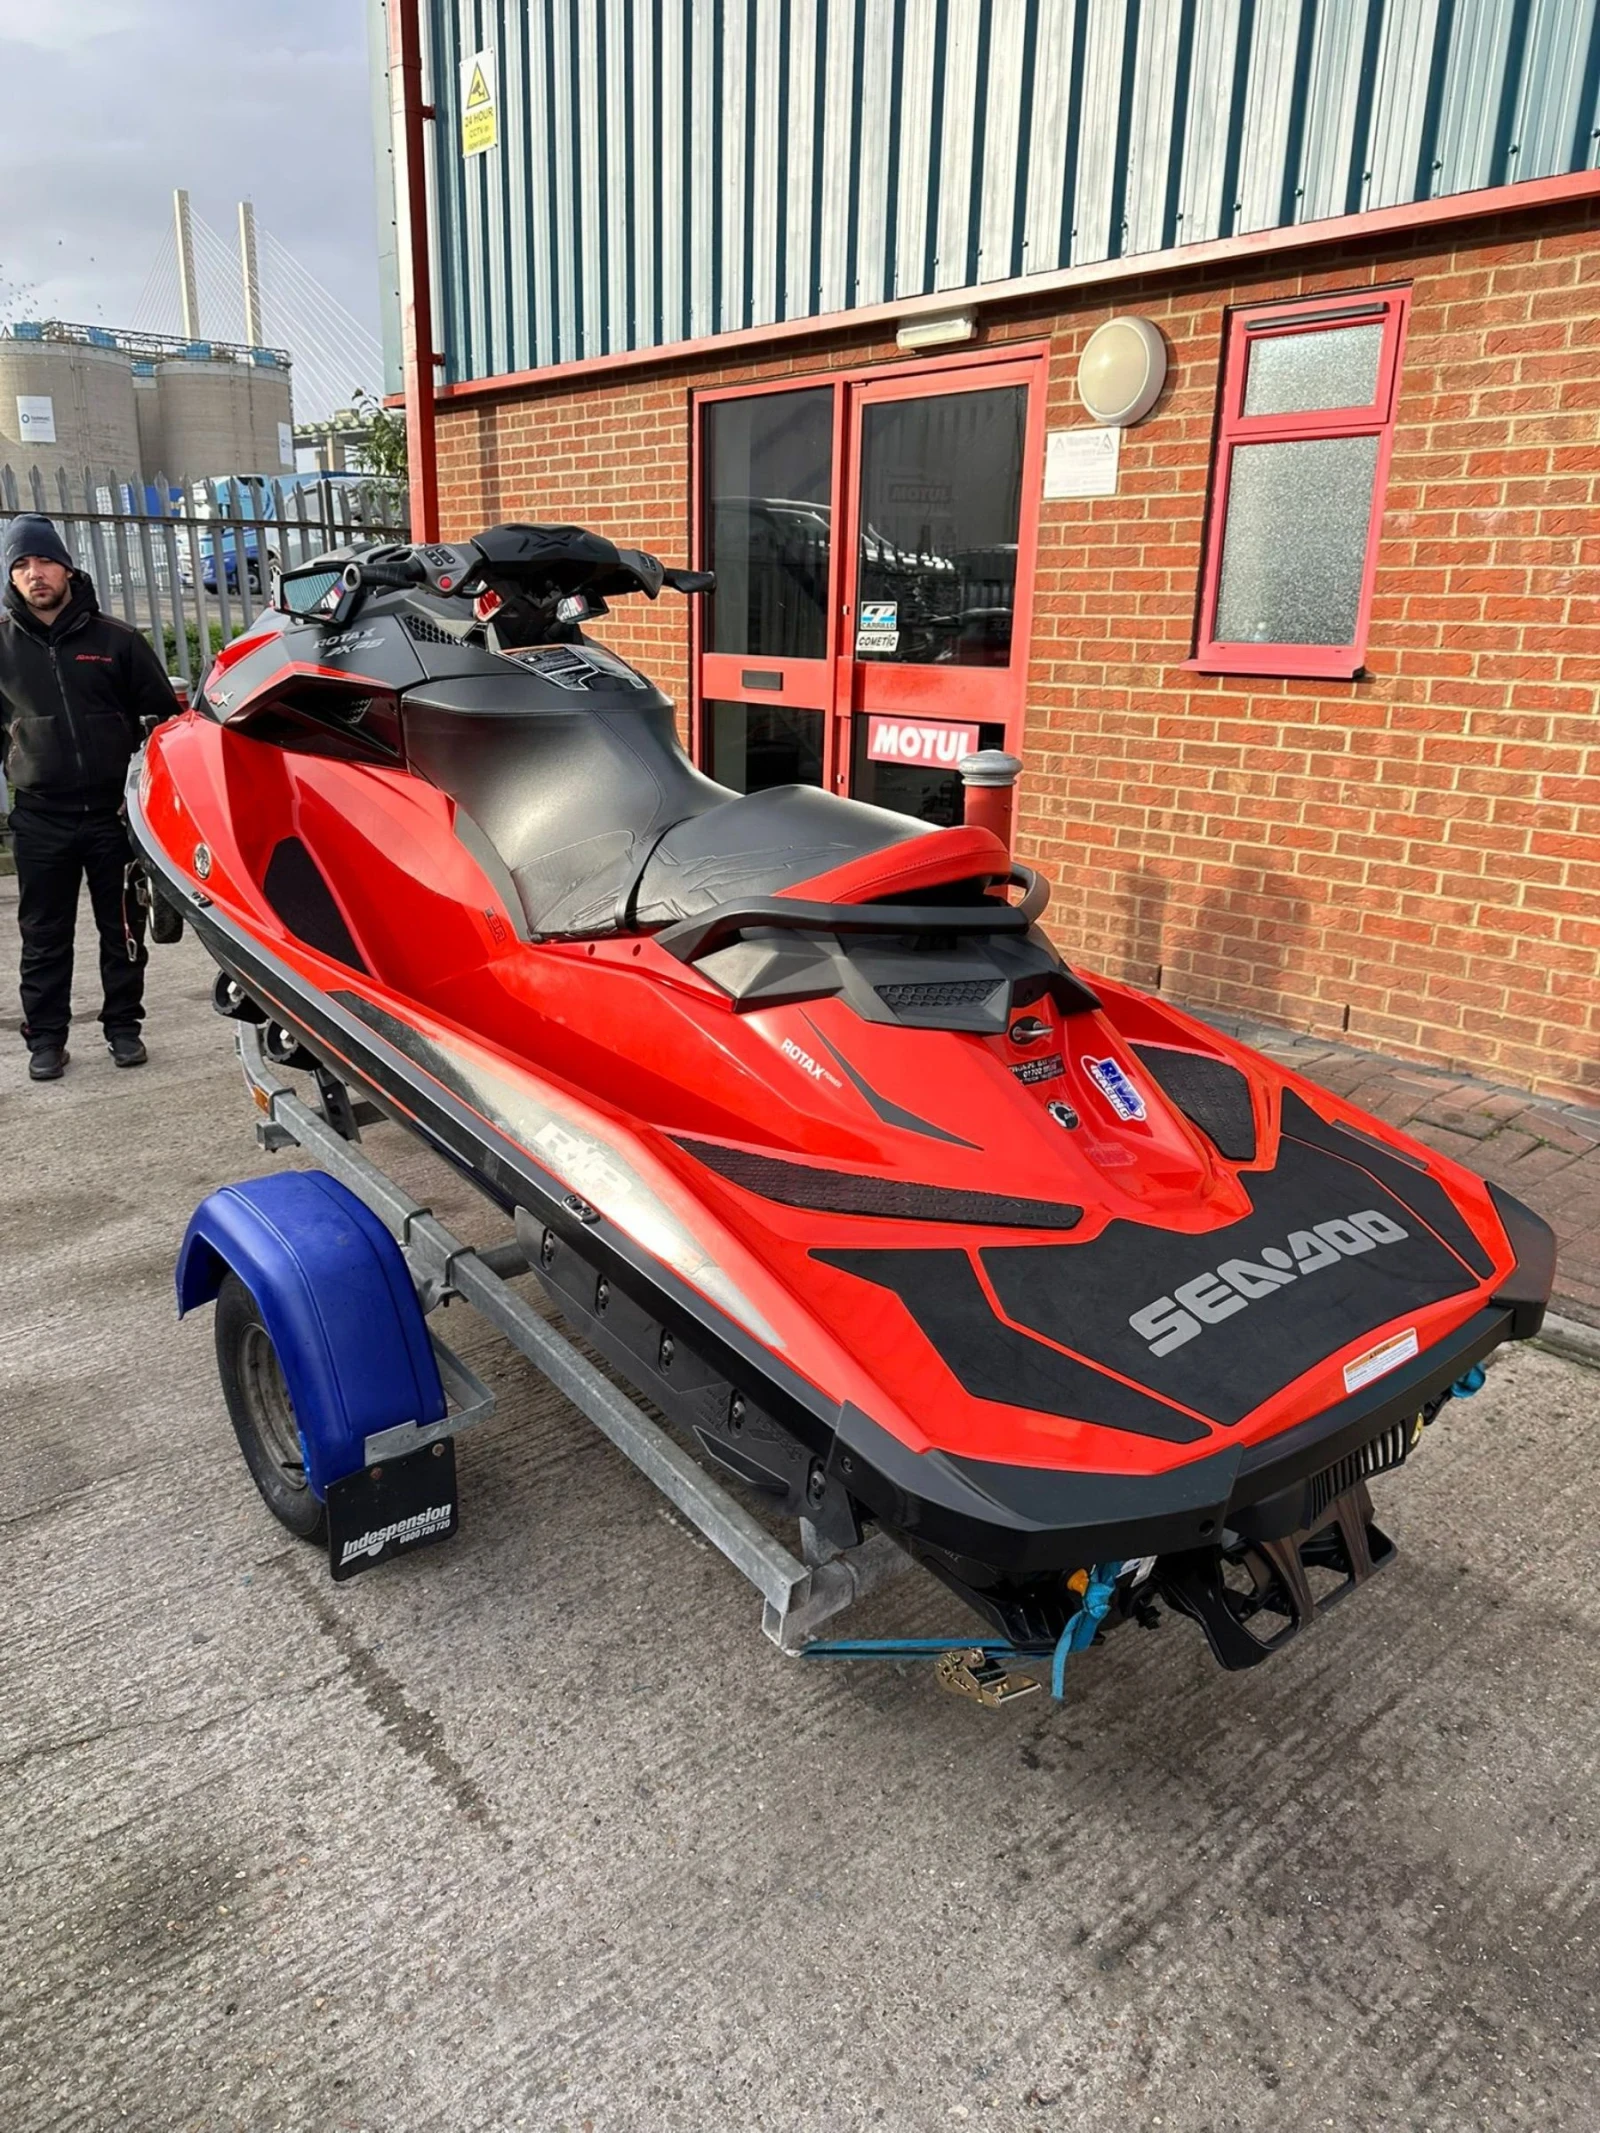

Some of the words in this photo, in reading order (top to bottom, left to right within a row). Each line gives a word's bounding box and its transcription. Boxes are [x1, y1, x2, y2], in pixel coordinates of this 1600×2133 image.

[473, 106, 493, 123] HOUR
[312, 627, 376, 649] ROTAX
[872, 723, 970, 764] MOTUL
[780, 1037, 826, 1081] ROTAX
[1090, 1064, 1130, 1118] RACING
[1099, 1061, 1140, 1112] RIVA
[341, 1502, 453, 1558] Indespension
[399, 1529, 421, 1544] 0800
